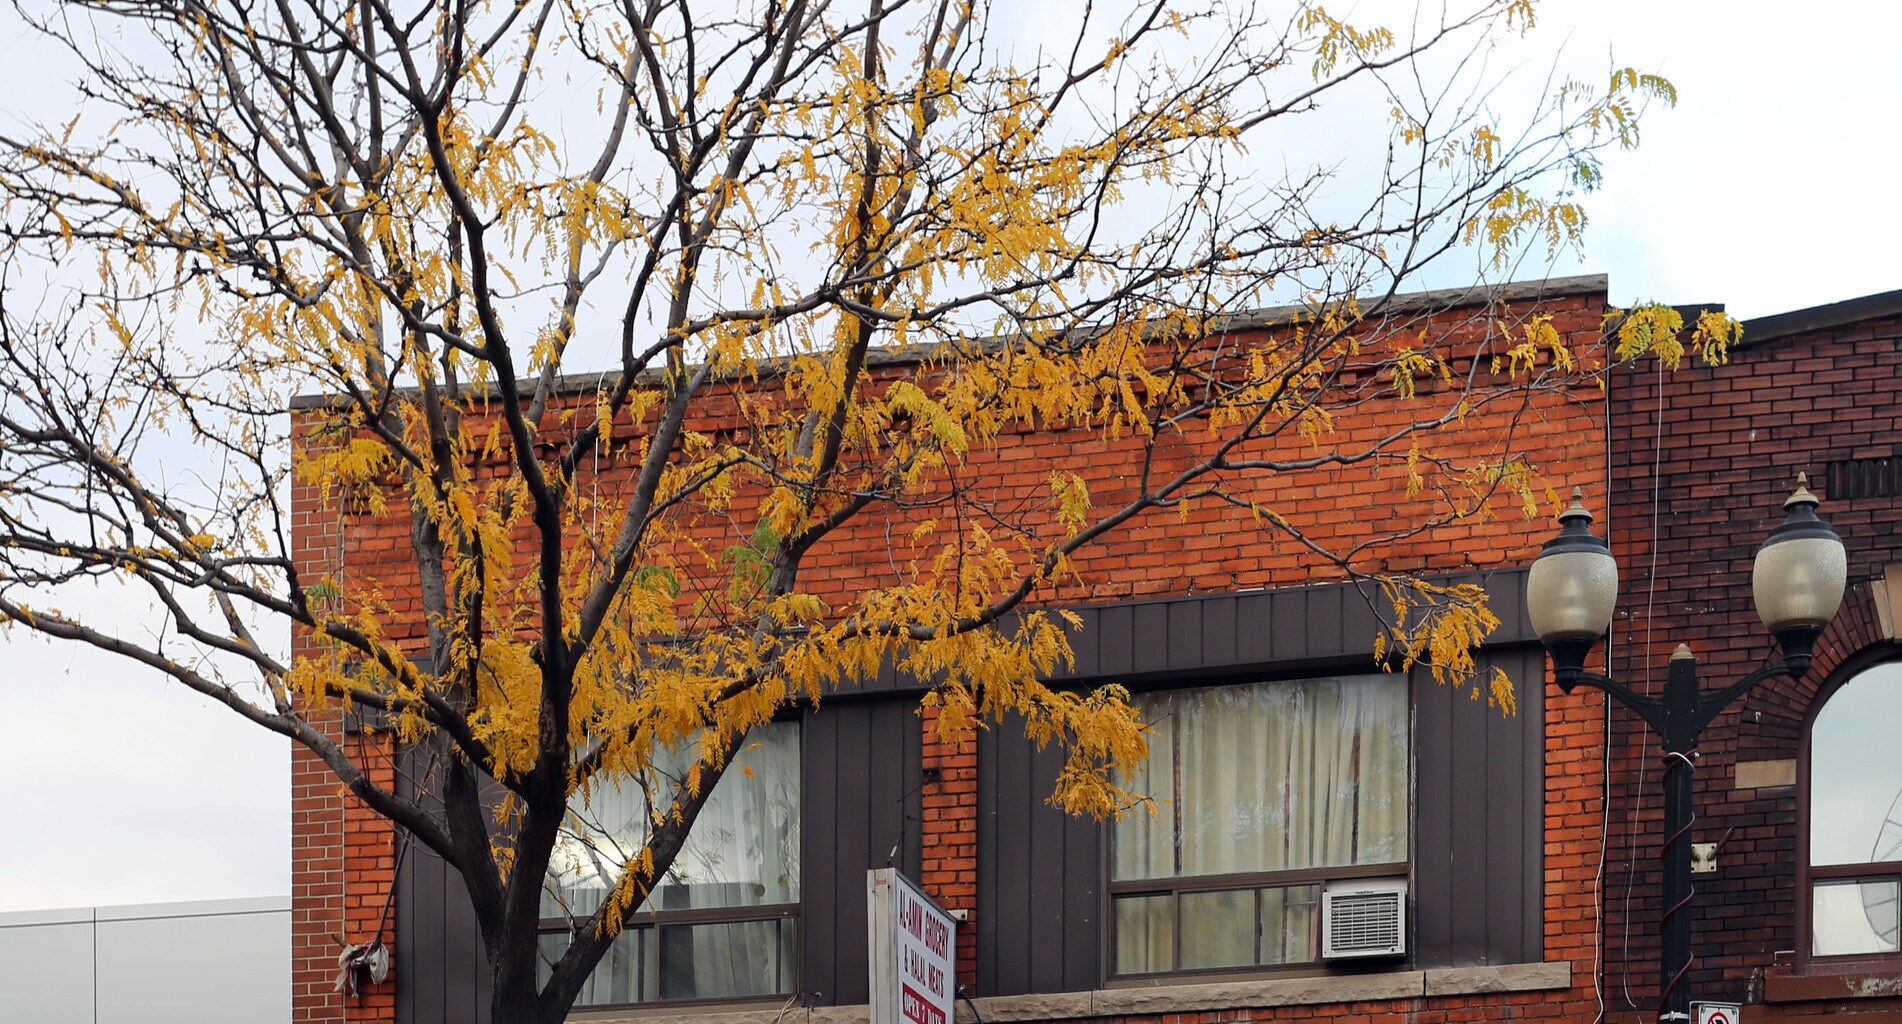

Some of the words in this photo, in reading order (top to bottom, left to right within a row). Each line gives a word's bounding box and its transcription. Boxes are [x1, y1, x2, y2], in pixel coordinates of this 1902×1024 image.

[925, 910, 949, 961] GROCERY
[904, 943, 909, 974] &
[911, 948, 926, 987] HALAL
[929, 963, 944, 999] MEATS
[904, 990, 920, 1019] OPEN
[922, 1004, 927, 1024] 7
